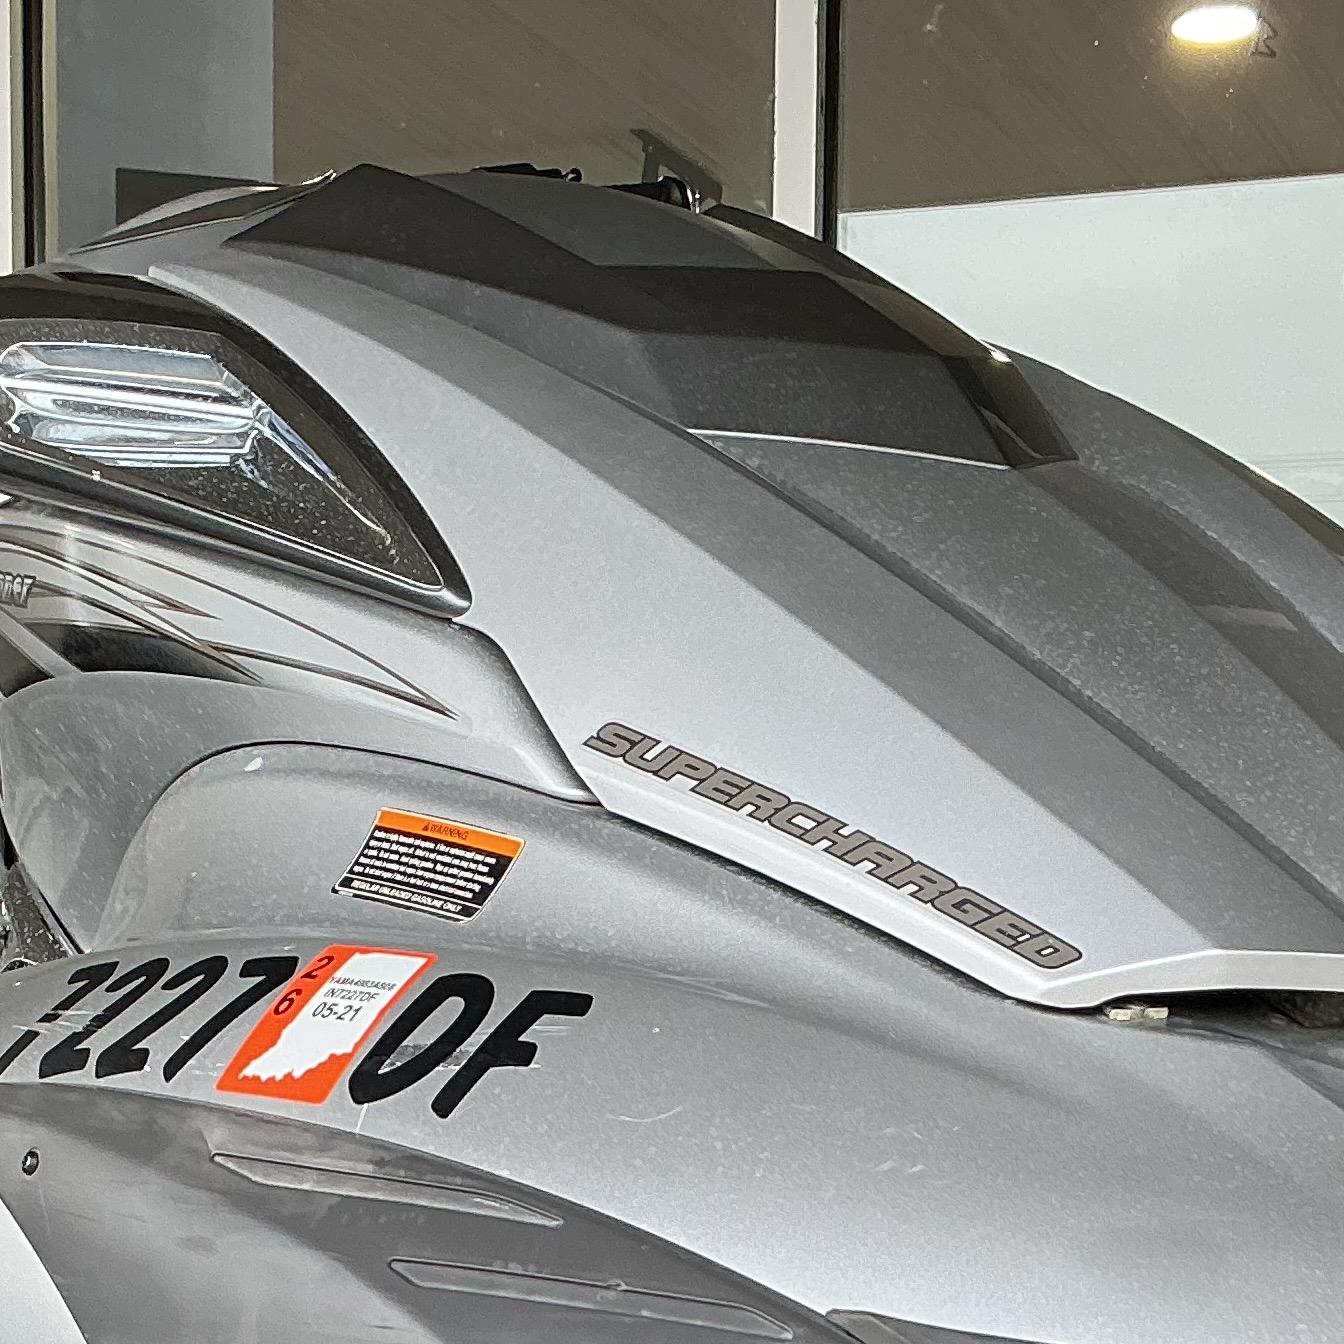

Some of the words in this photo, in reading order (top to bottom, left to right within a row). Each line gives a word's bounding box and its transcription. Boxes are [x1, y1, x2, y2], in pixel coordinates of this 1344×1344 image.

[429, 823, 470, 841] WARNING
[583, 721, 1083, 969] SUPERCHARGED
[443, 901, 463, 912] ONLY
[312, 1002, 362, 1022] 05-21
[348, 972, 594, 1119] DF
